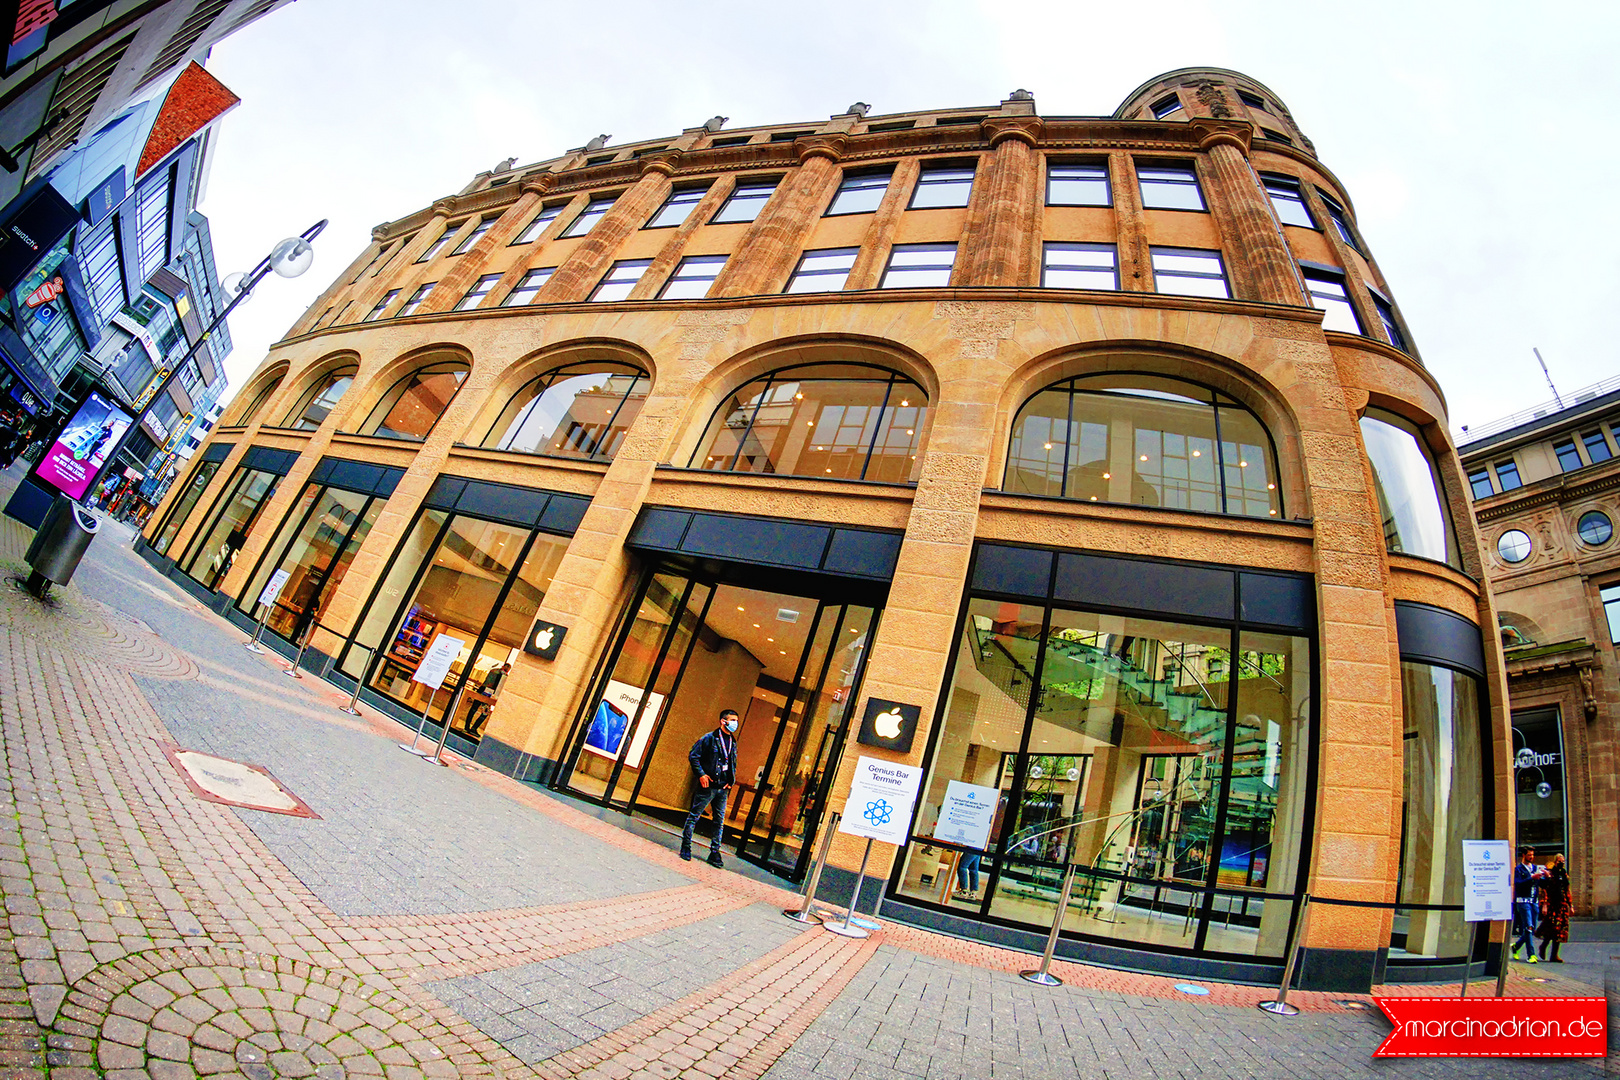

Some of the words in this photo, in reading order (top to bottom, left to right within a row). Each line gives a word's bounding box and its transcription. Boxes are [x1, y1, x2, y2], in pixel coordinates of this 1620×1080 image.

[12, 226, 36, 249] swatch
[620, 693, 640, 705] iPhon
[868, 764, 895, 776] Genius
[896, 770, 909, 779] Bar
[872, 773, 902, 786] Termine
